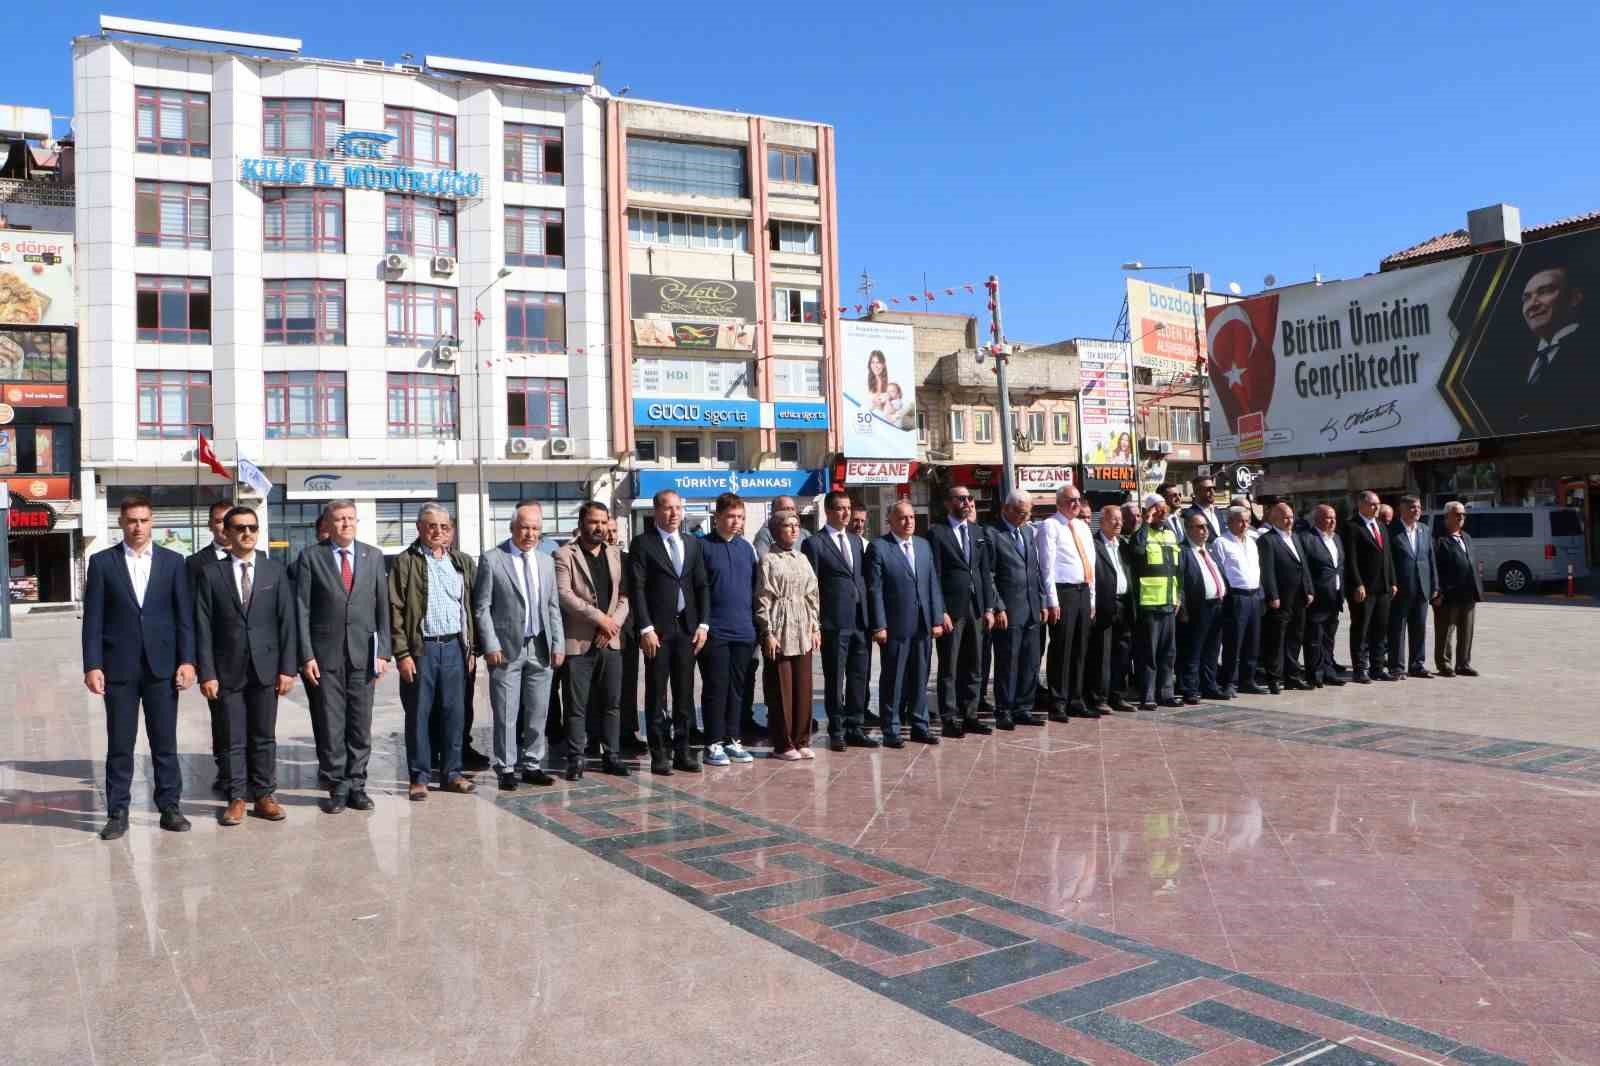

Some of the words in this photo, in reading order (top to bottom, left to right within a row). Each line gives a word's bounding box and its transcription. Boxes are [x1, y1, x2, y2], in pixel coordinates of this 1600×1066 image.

[1281, 315, 1342, 357] Bütün
[1349, 298, 1430, 346] Ümidim
[1295, 345, 1419, 399] Gençliktedir
[704, 408, 747, 425] sigorta
[848, 463, 907, 476] ECZANE
[1020, 469, 1071, 482] ECZANE
[308, 481, 332, 491] SGK
[675, 476, 726, 488] TÜRKİYE
[741, 478, 792, 488] BANKASI
[5, 509, 48, 529] ÖNER
